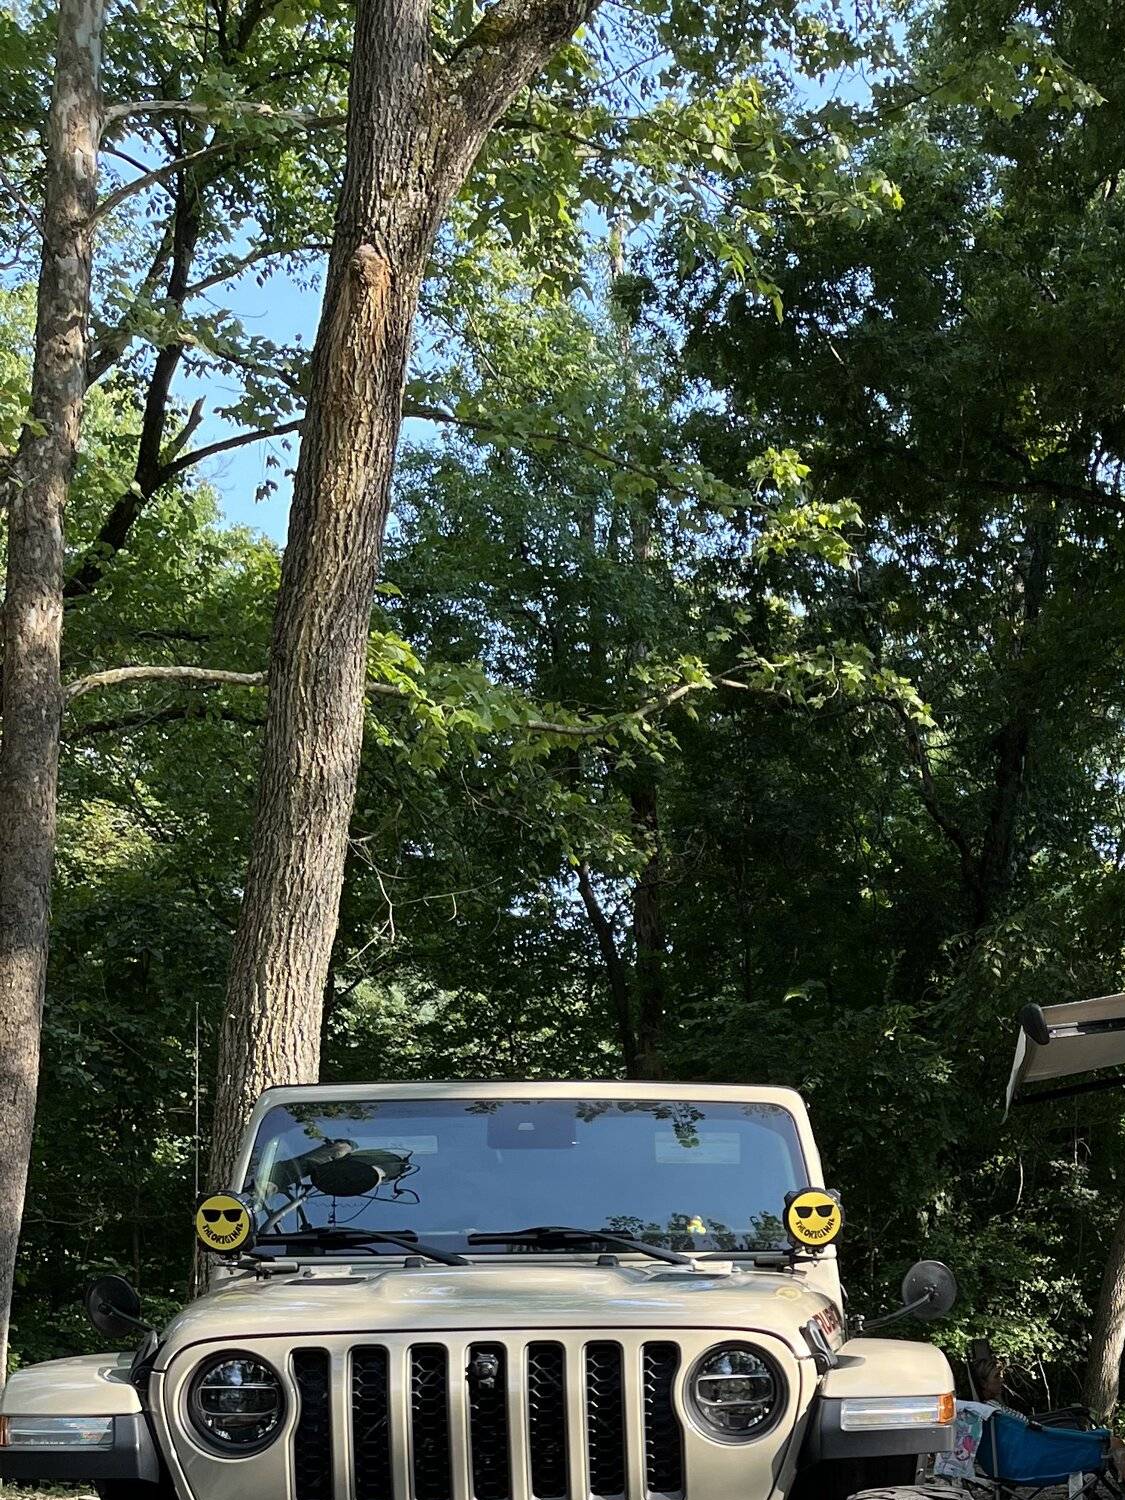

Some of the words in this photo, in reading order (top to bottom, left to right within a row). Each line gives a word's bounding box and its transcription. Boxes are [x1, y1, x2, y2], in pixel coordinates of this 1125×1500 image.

[202, 1224, 213, 1238] THE
[210, 1223, 244, 1244] ORIGINAL
[796, 1220, 806, 1233] THE
[804, 1218, 835, 1239] ORIGINAL
